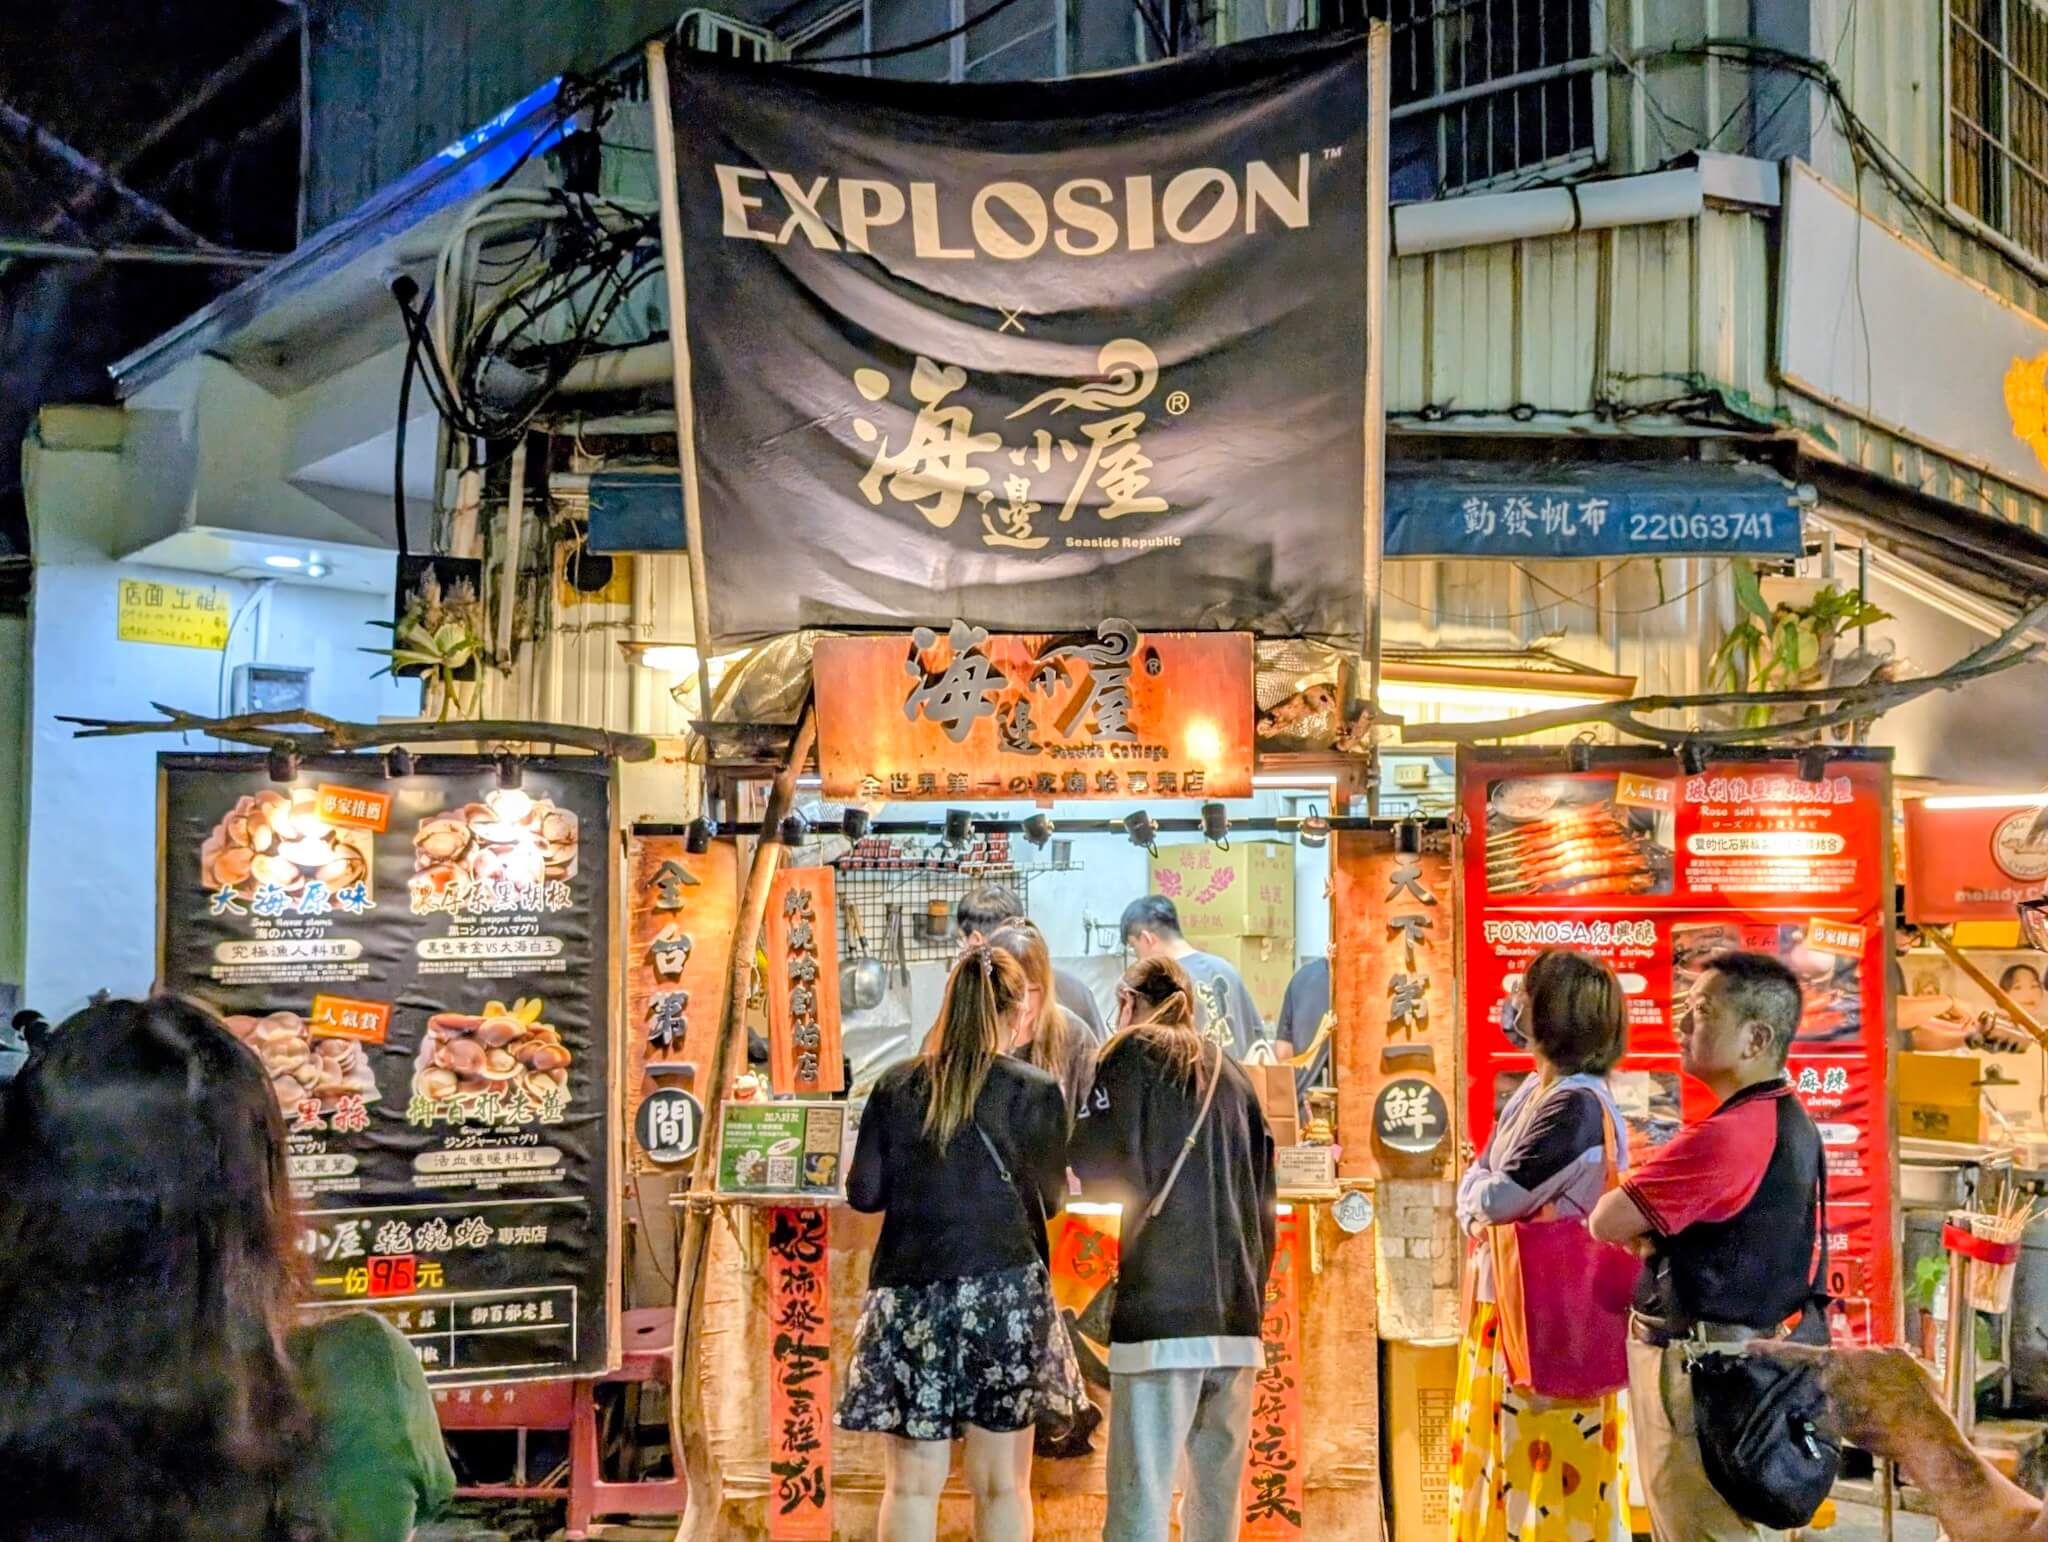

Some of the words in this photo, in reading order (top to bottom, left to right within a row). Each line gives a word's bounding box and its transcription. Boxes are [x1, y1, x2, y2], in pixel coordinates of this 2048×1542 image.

[714, 152, 1311, 260] EXPLOSION
[1462, 496, 1609, 538] 勤發帆布
[1629, 512, 1773, 542] 22063741
[1065, 536, 1119, 549] Seaside
[1121, 535, 1182, 548] Republic
[1701, 805, 1728, 816] Rose
[209, 879, 377, 916] 大海原味
[373, 1216, 494, 1254] 乾燒蛤
